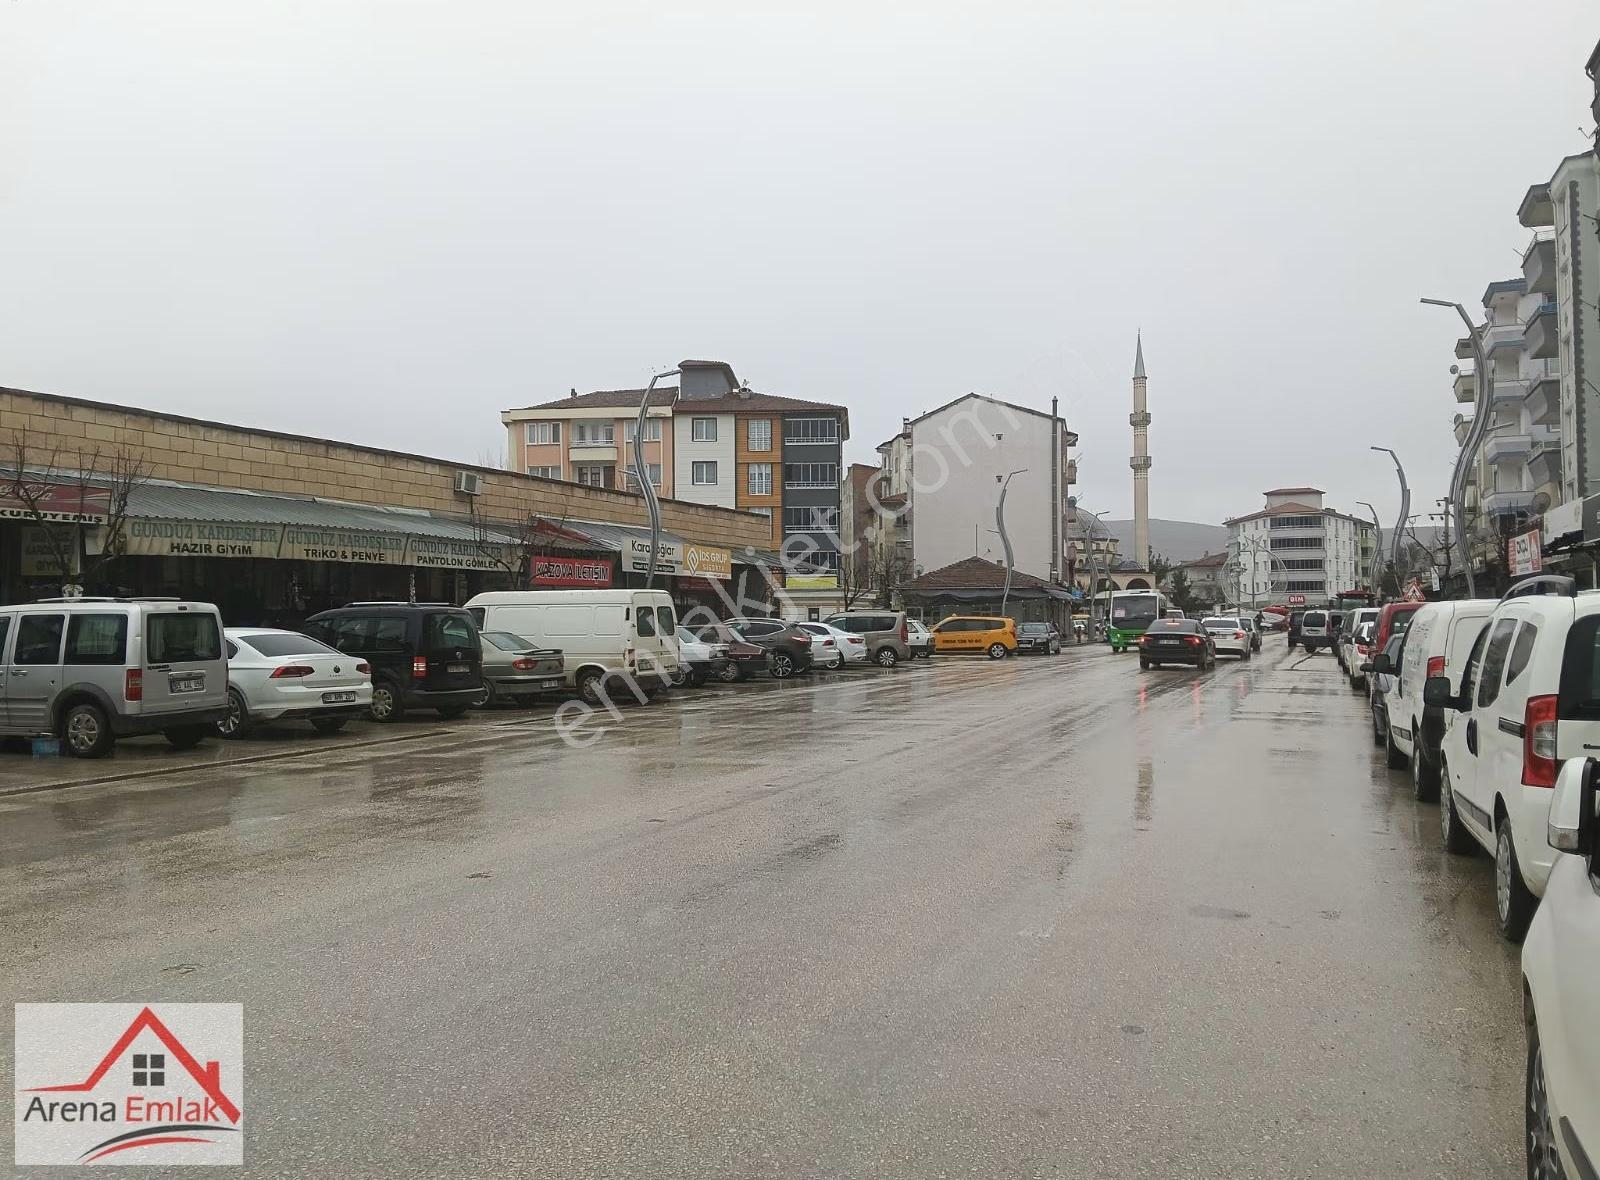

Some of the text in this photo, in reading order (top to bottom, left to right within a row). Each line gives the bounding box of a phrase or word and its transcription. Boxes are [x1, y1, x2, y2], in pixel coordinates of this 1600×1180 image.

[171, 542, 213, 554] HAZIR
[341, 550, 348, 559] &
[352, 551, 385, 561] PENYE
[417, 555, 463, 567] PANTOLON
